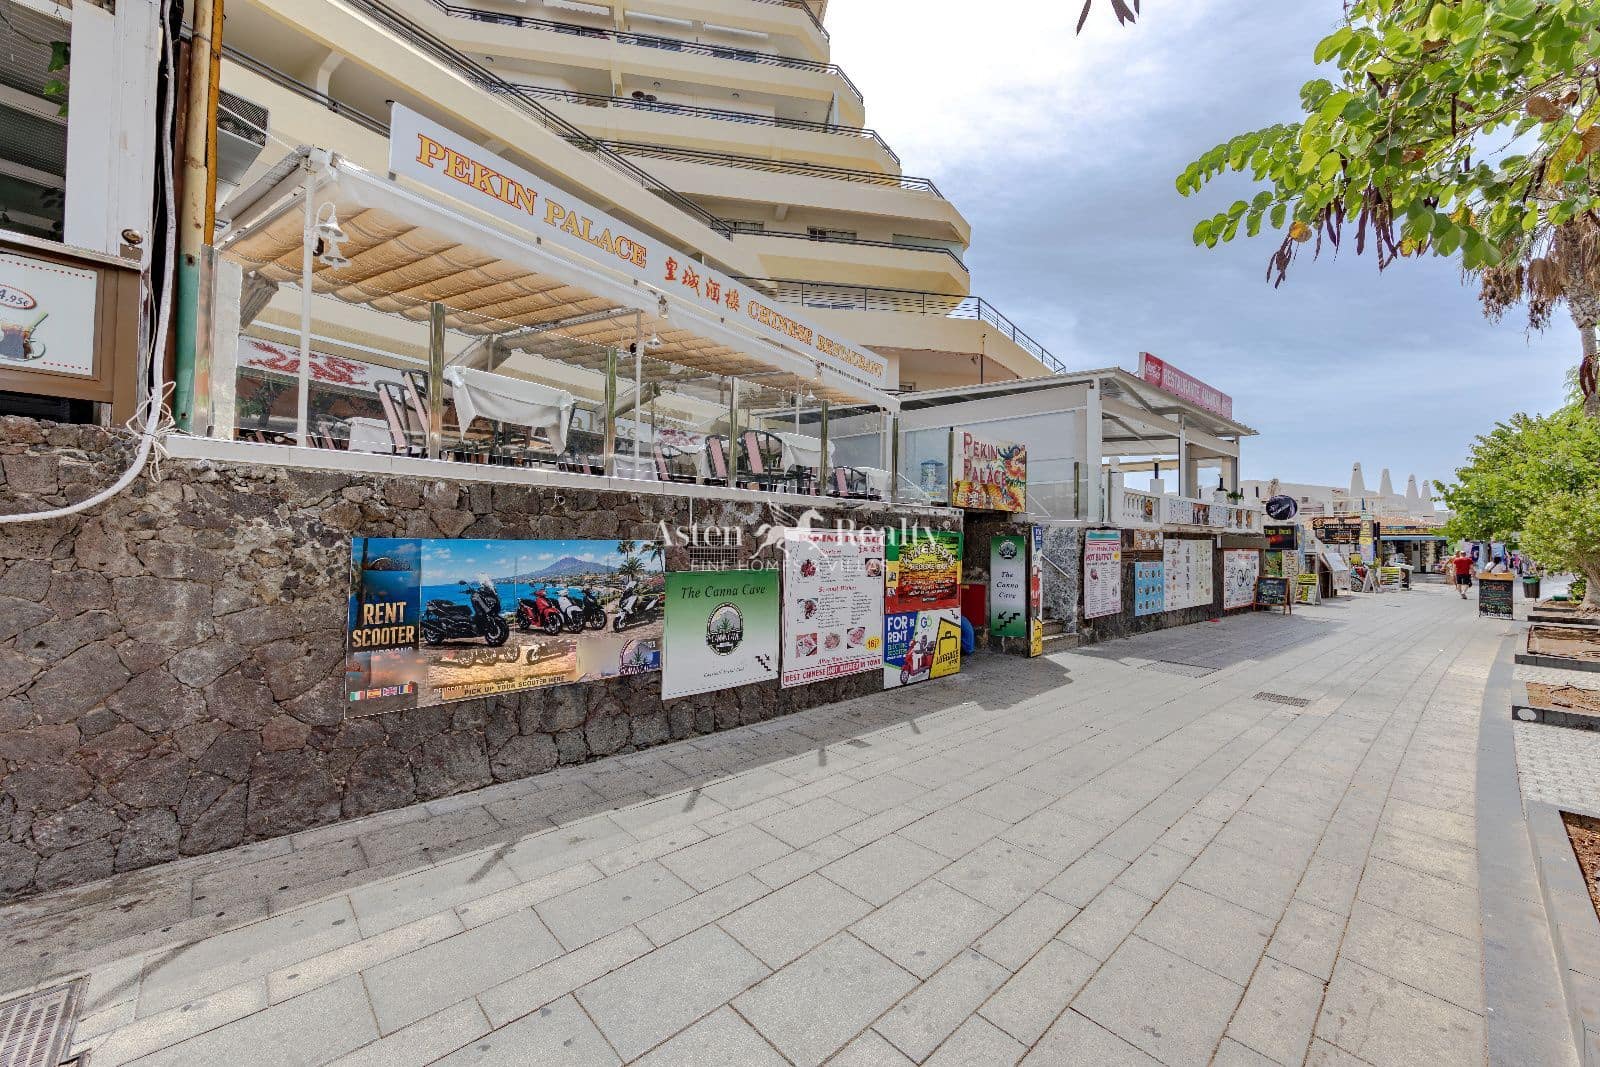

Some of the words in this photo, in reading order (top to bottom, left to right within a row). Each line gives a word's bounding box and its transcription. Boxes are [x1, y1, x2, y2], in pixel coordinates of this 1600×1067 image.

[416, 133, 537, 215] PEKIN
[544, 198, 647, 268] PALACE
[747, 300, 813, 346] CHINESE
[816, 334, 884, 378] RESTAURANT
[963, 432, 998, 460] PEKIN
[963, 458, 1007, 487] PALACE
[681, 586, 701, 599] The
[704, 585, 738, 598] Canna
[742, 583, 766, 595] Cave
[996, 581, 1019, 589] Canna
[363, 601, 407, 625] RENT
[887, 615, 908, 631] FOR
[351, 625, 415, 648] SCOOTER
[887, 630, 908, 643] RENT
[464, 688, 481, 696] PICK
[497, 682, 516, 691] YOUR
[518, 678, 547, 688] SCOOTER
[548, 675, 565, 684] HERE
[784, 673, 801, 683] BEST
[802, 668, 827, 679] CHINESE
[828, 666, 838, 675] HOT
